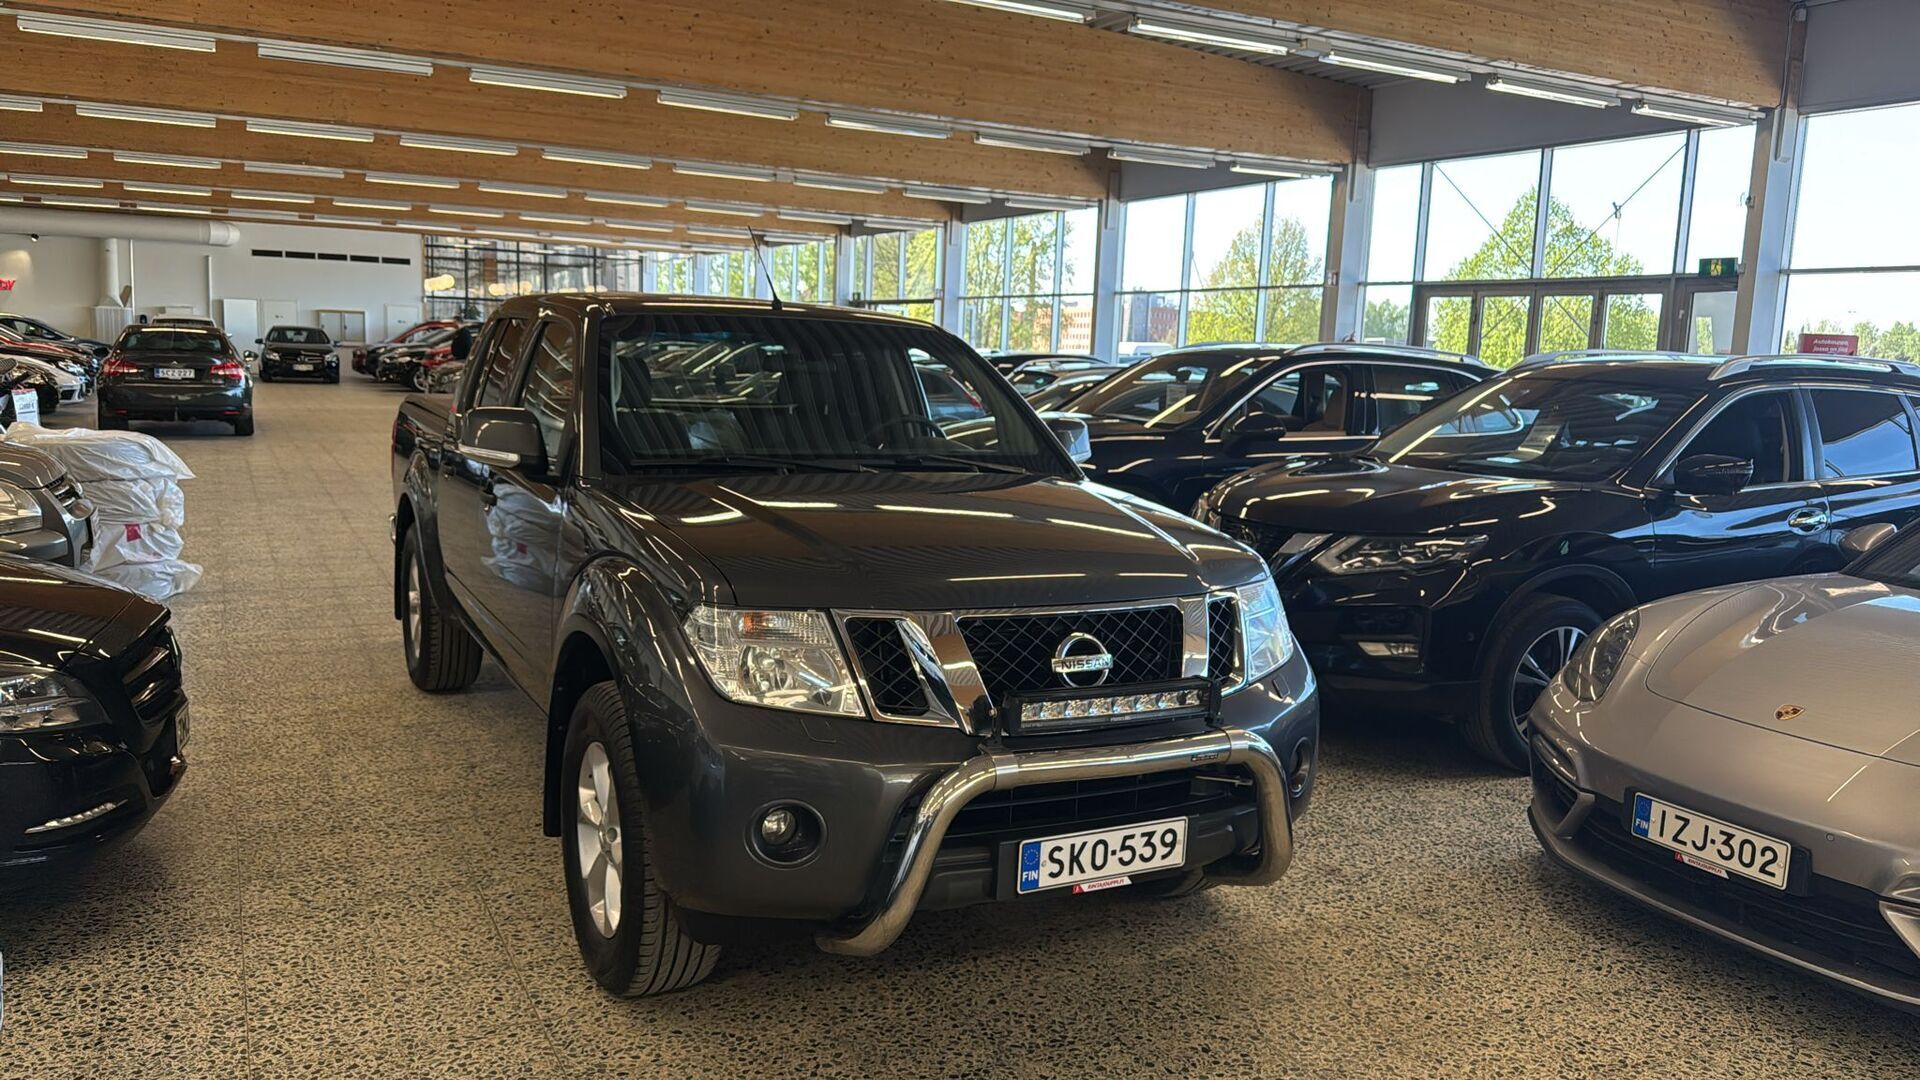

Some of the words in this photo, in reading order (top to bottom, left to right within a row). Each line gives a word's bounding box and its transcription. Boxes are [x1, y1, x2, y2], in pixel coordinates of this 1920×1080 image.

[1061, 658, 1109, 670] NISSAN
[1635, 818, 1648, 830] FIN
[1659, 810, 1778, 878] IZJ-302
[1048, 828, 1178, 879] SKO-539
[1022, 869, 1039, 882] FIN
